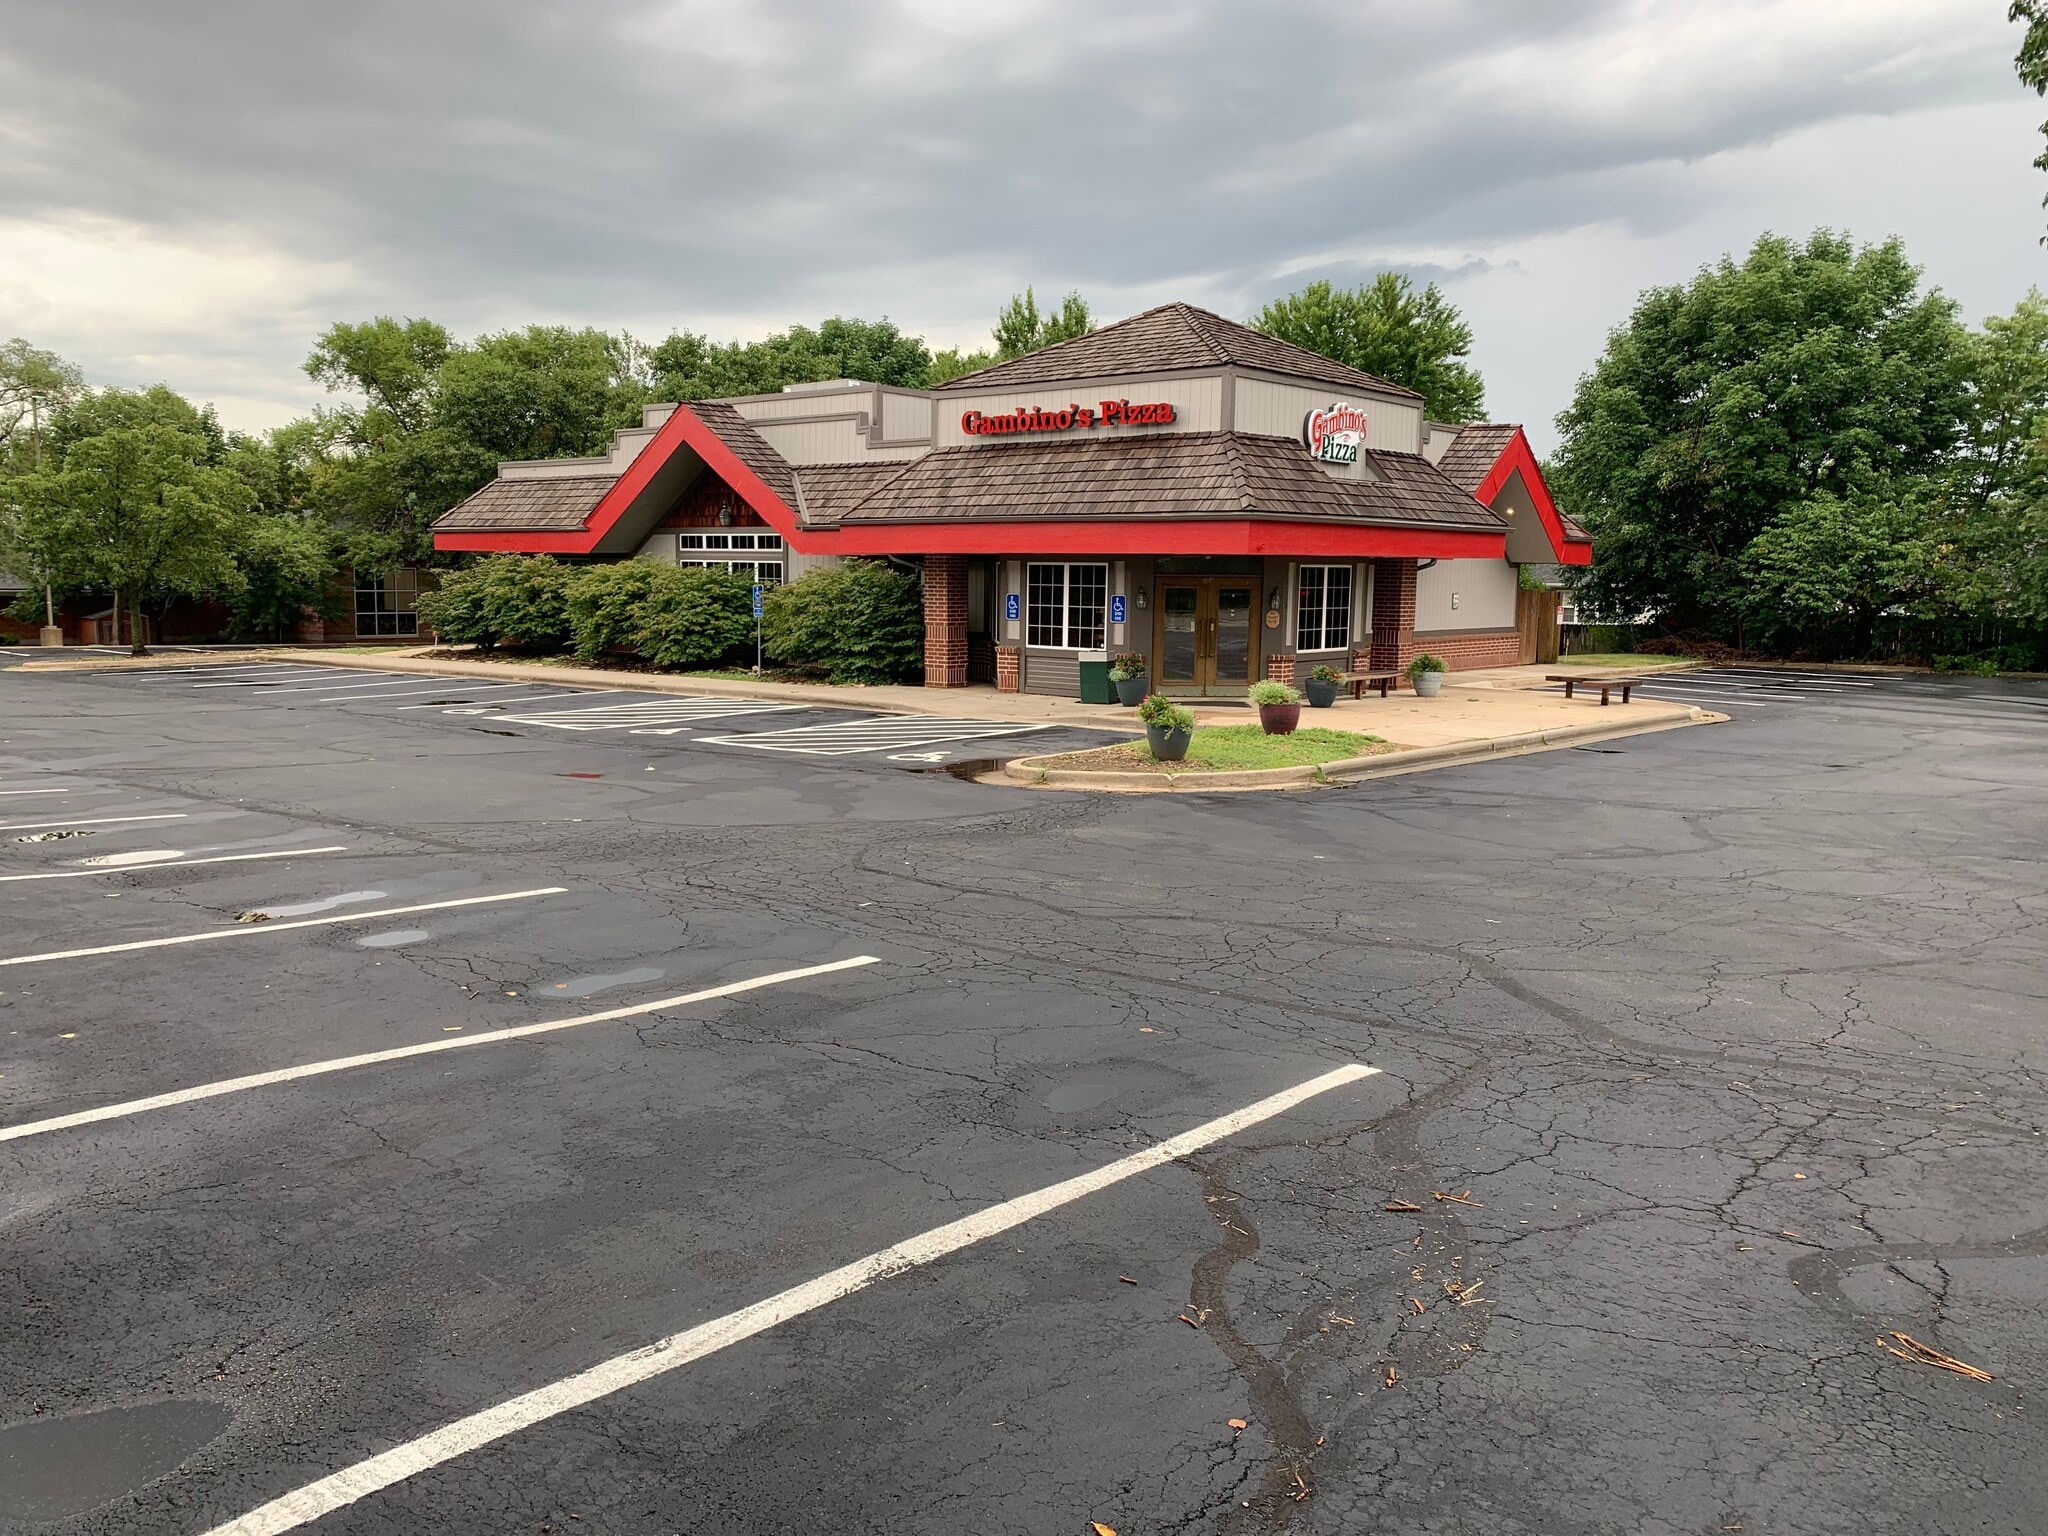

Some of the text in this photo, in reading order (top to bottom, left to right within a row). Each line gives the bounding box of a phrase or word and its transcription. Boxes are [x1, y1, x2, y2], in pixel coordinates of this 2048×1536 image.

[961, 399, 1175, 435] Gambino's Pizza
[1312, 404, 1367, 453] Gambino's
[1320, 434, 1357, 462] Pizza
